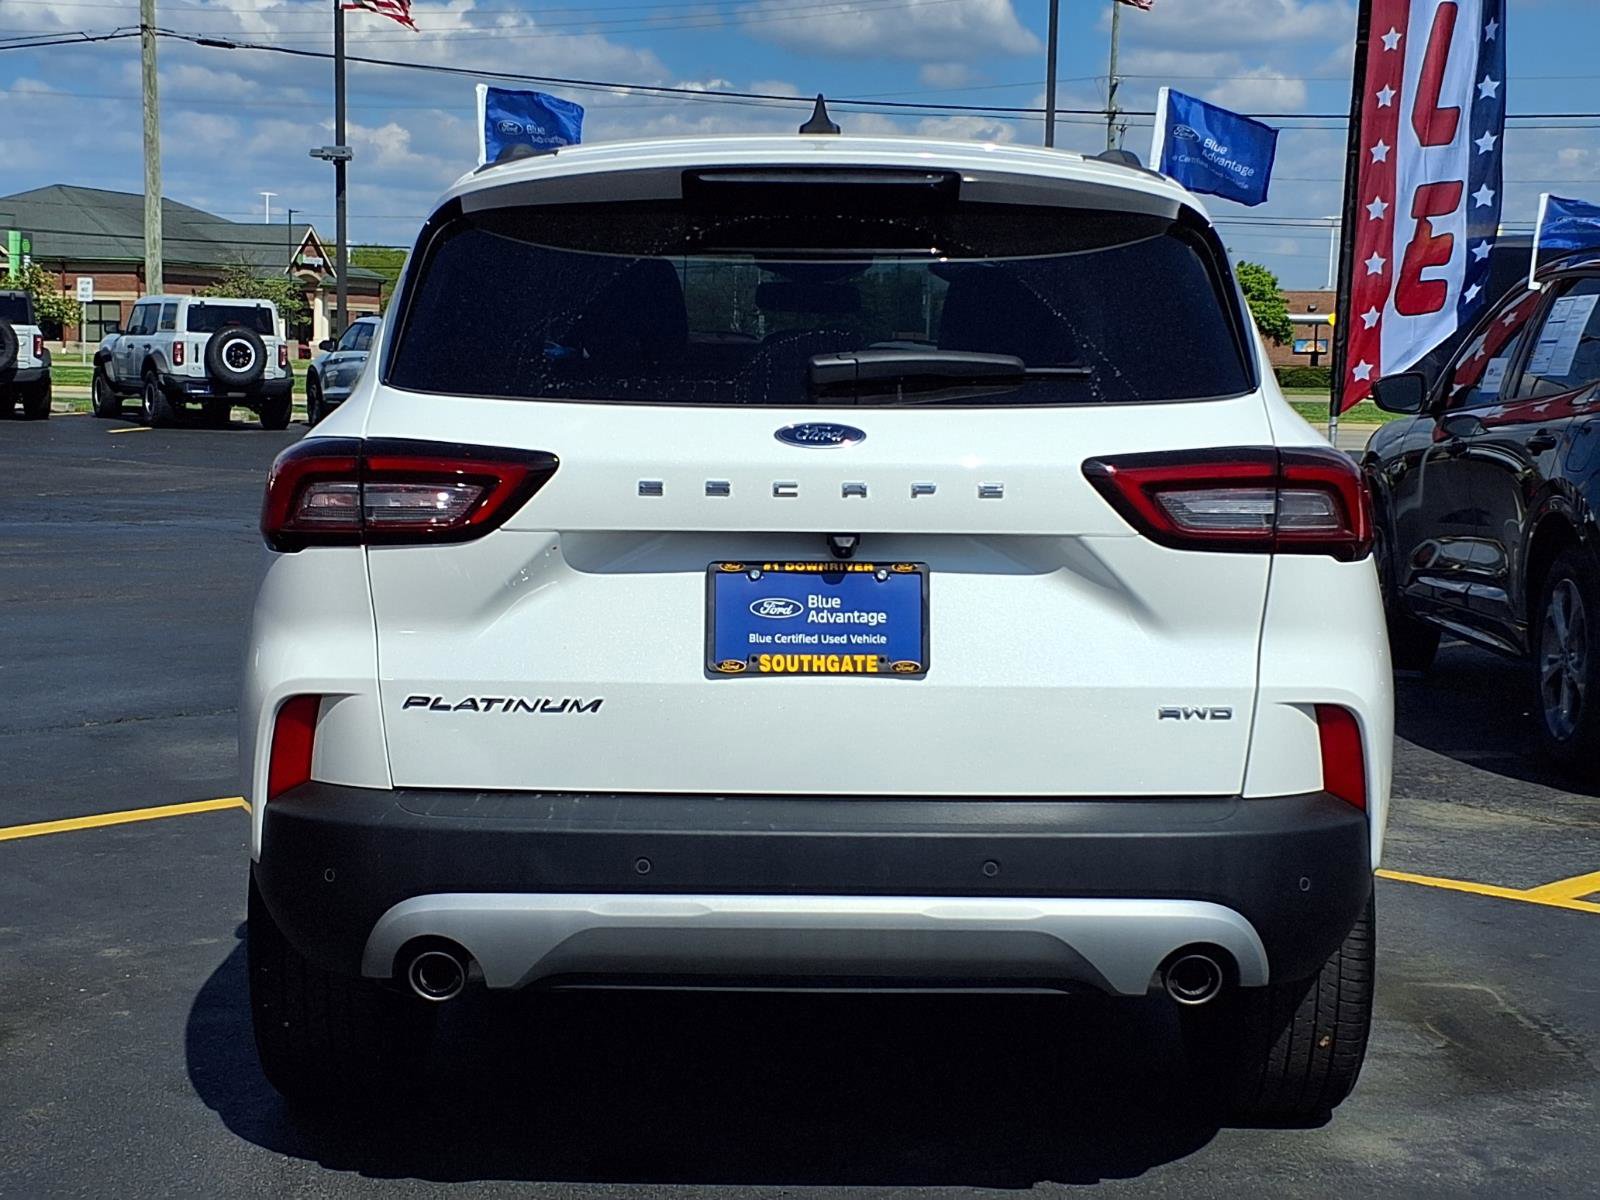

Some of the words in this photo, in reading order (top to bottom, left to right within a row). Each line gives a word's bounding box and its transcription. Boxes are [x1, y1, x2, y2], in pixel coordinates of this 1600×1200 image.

[526, 124, 546, 135] Blue
[1173, 126, 1196, 139] Ford
[1203, 138, 1228, 154] Blue
[1201, 149, 1255, 177] Advantage
[638, 480, 1003, 499] ESCAPE
[784, 562, 875, 572] DOWNRIVER
[759, 600, 793, 617] Ford
[808, 595, 841, 609] Blue
[807, 610, 887, 626] Advantage
[749, 633, 772, 644] Blue
[774, 633, 819, 645] Certified
[821, 634, 848, 645] Used
[850, 633, 888, 645] Vehicle
[759, 654, 878, 673] SOUTHGATE
[402, 695, 604, 713] PLATINUM
[1158, 706, 1233, 721] AWD
